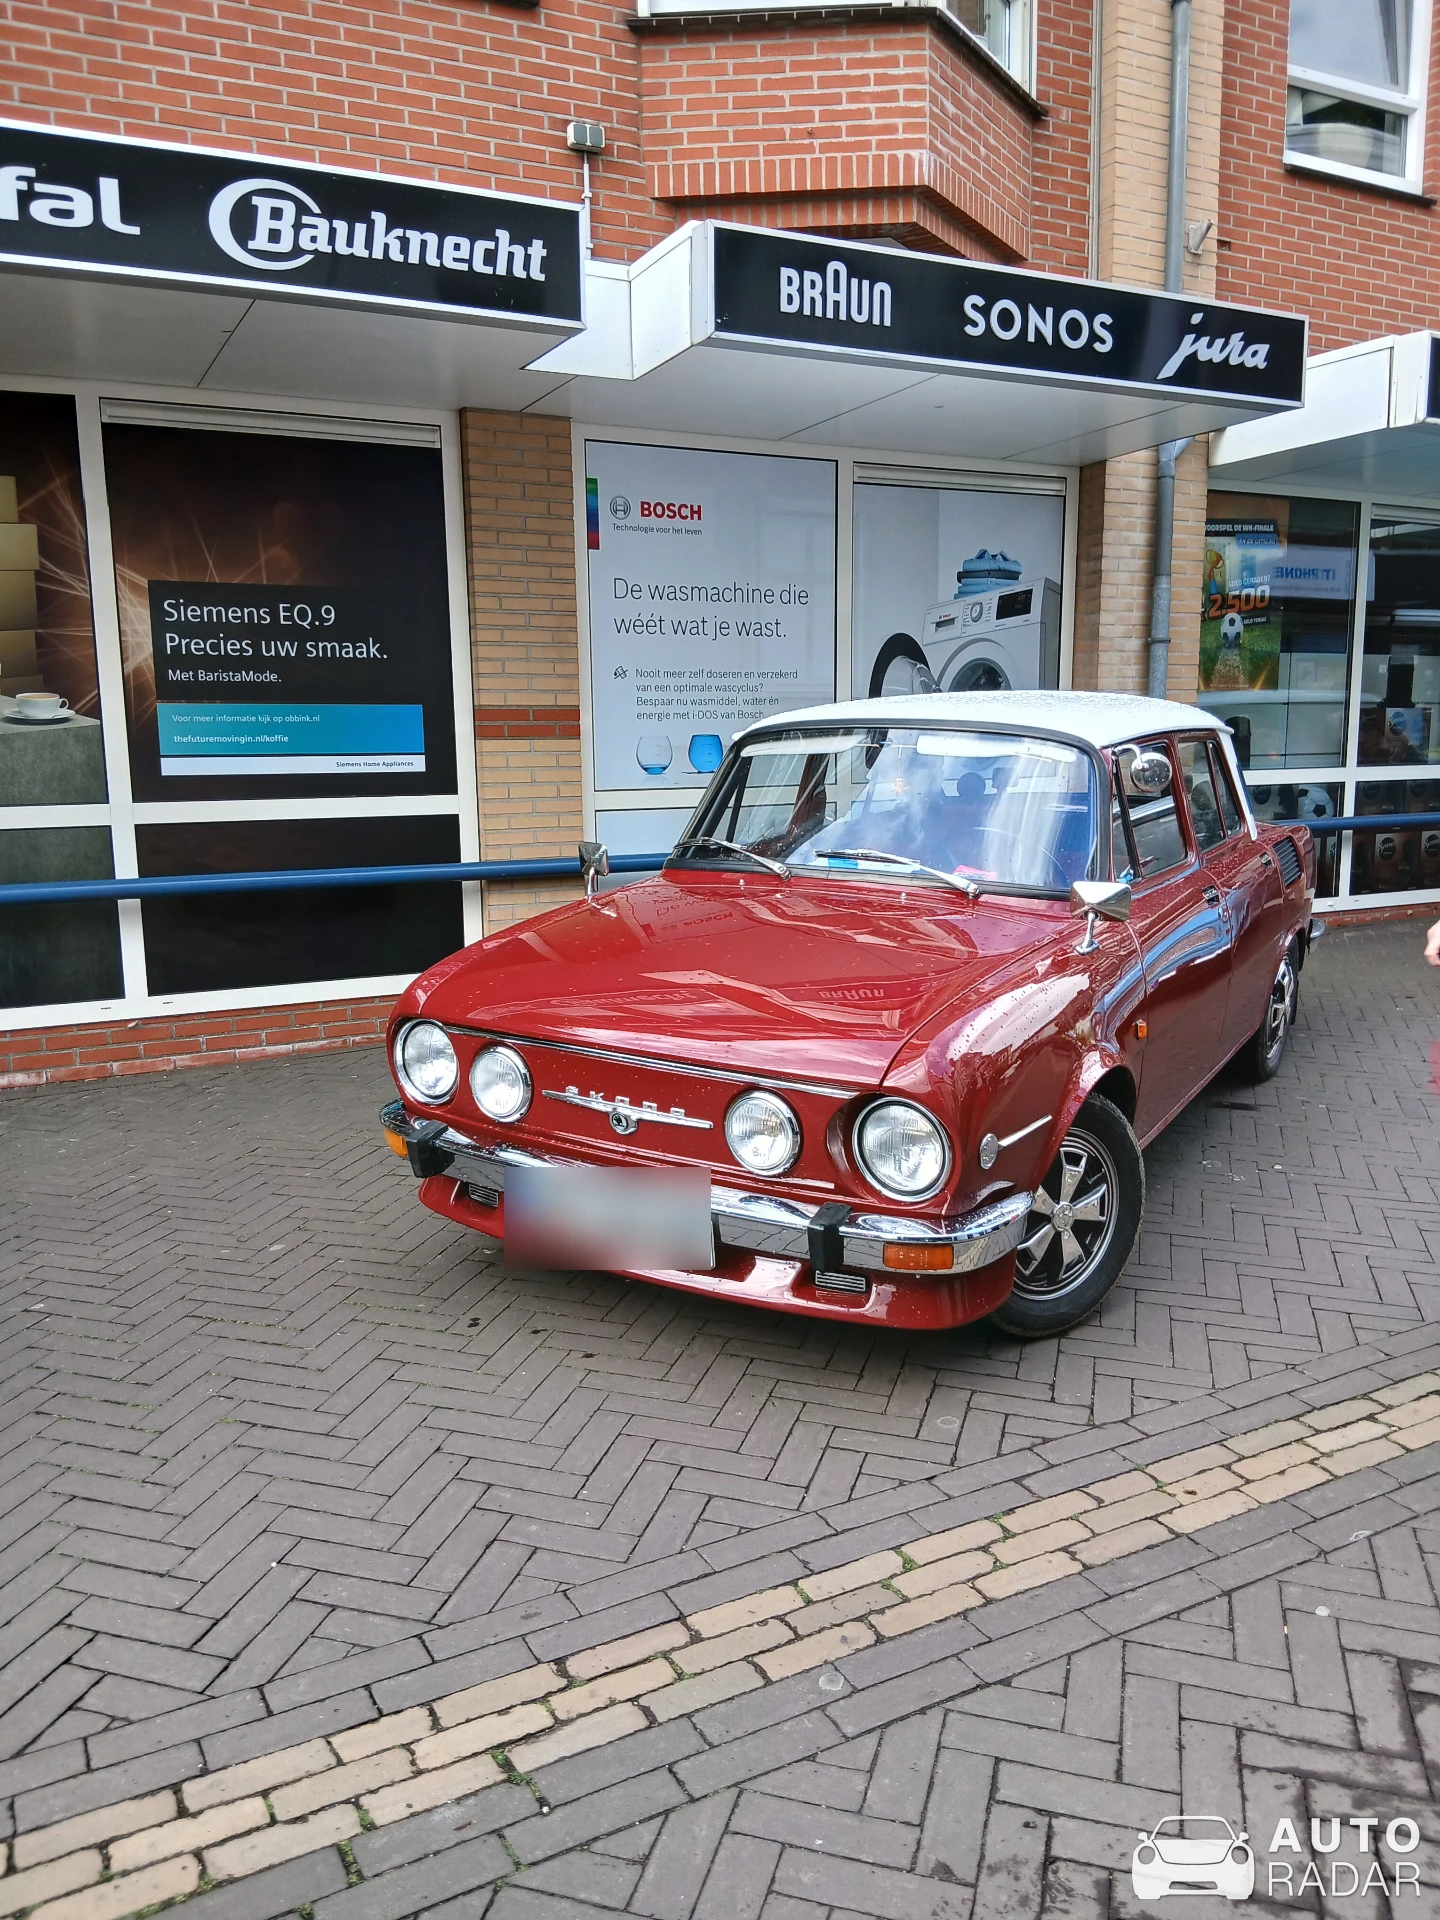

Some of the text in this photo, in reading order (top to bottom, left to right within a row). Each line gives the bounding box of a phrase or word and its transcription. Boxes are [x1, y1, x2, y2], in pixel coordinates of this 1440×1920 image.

[247, 195, 548, 282] Bauknecht
[778, 260, 893, 328] BRAUN
[963, 294, 1114, 353] SONOS
[1155, 312, 1271, 380] jura
[640, 500, 702, 521] BOSCH
[612, 523, 654, 535] Technologie
[672, 526, 683, 535] het
[684, 528, 703, 536] leven
[613, 577, 809, 605] De wasmachine die
[1208, 584, 1270, 618] 2.500
[163, 598, 336, 629] Siemens EQ.9
[613, 612, 787, 640] wéét wat je wast.
[165, 633, 388, 659] Precies uw smaak.
[168, 669, 282, 683] Met BaristaMode.
[635, 668, 798, 679] Nooit meer zelf doseren en verzekerd
[635, 682, 764, 694] van een optimale wascyclus?
[636, 697, 779, 708] Bespaar nu wasmiddel, water én
[172, 714, 320, 724] Voor meer informatie kijk op obbink.nl
[636, 711, 671, 722] energie
[673, 711, 690, 720] met
[692, 710, 719, 720] i-DOS
[720, 712, 736, 720] van
[173, 734, 289, 745] thefuturemovingin.nl/koffie
[335, 760, 362, 768] Siemens
[381, 760, 414, 769] Appliances
